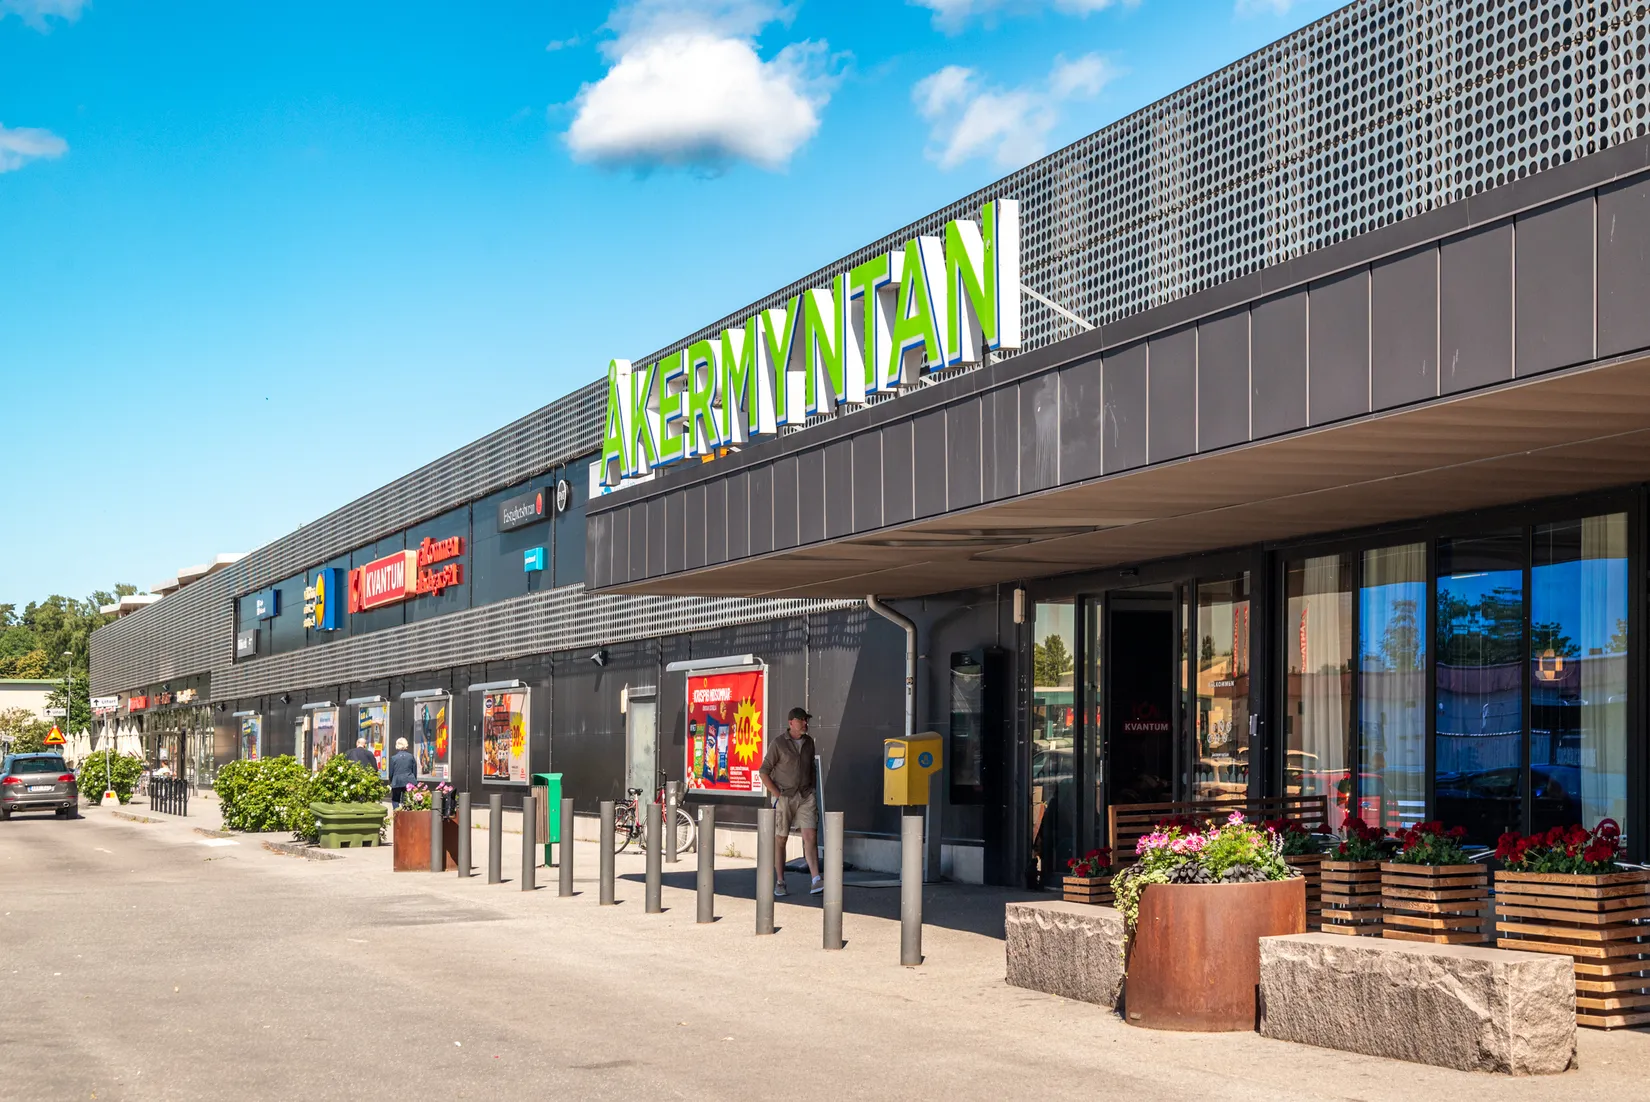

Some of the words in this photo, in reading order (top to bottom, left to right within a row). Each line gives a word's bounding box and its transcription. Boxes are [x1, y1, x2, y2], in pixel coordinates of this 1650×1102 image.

[599, 199, 1008, 487] ÅKERMYNTAN
[366, 560, 405, 598] KVANTUM
[1124, 723, 1169, 731] KVANTUM
